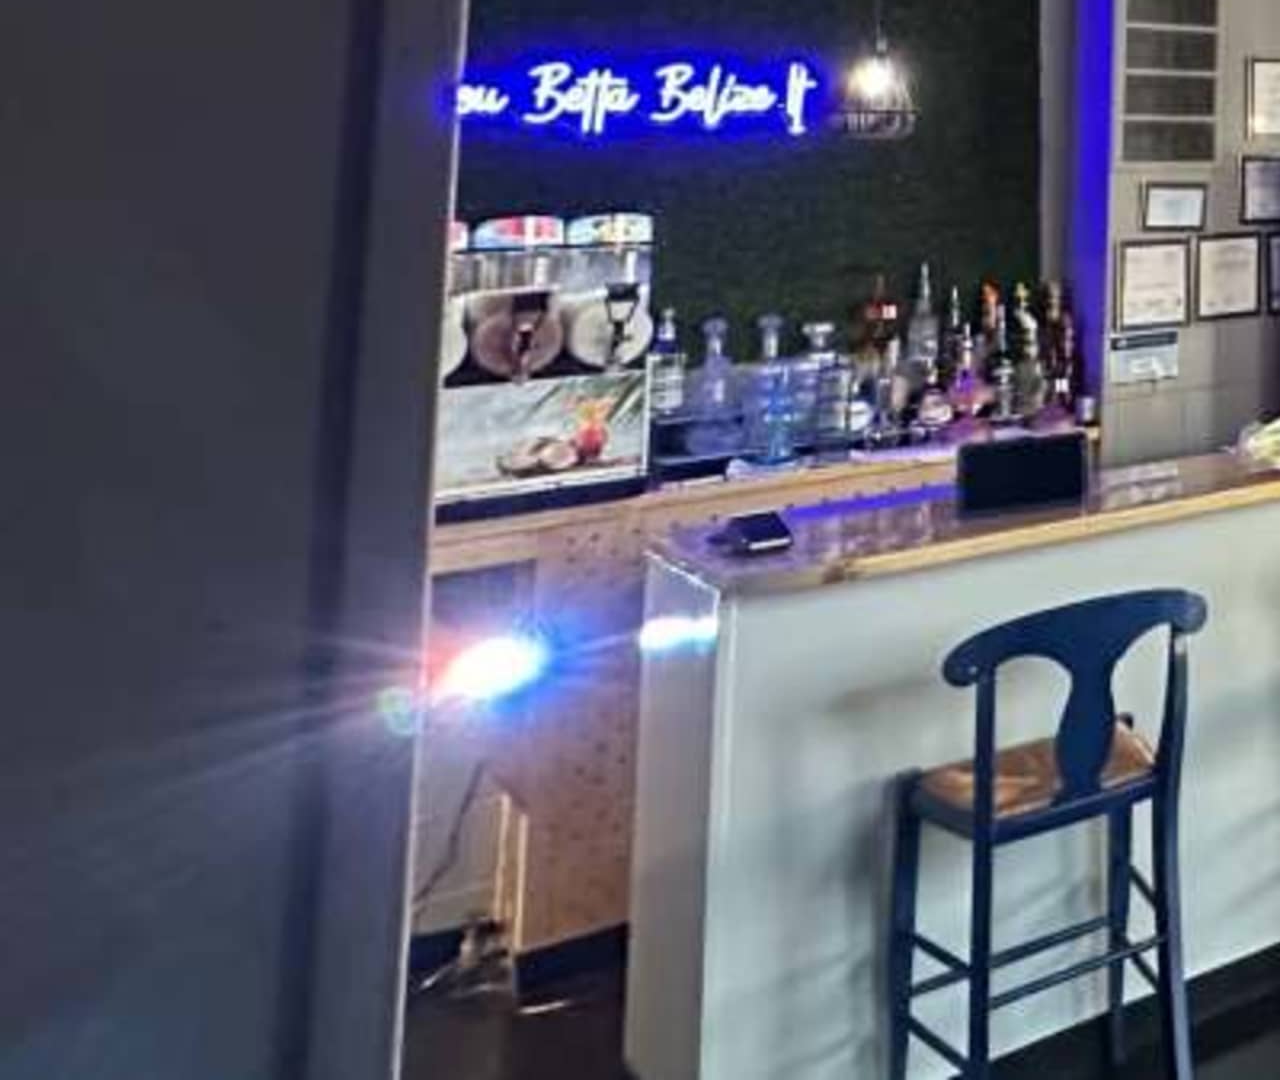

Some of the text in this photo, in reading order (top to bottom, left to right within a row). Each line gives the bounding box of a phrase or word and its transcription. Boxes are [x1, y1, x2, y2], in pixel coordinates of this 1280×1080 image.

[457, 84, 510, 115] ou
[523, 62, 640, 134] Betta
[650, 63, 777, 128] Belize
